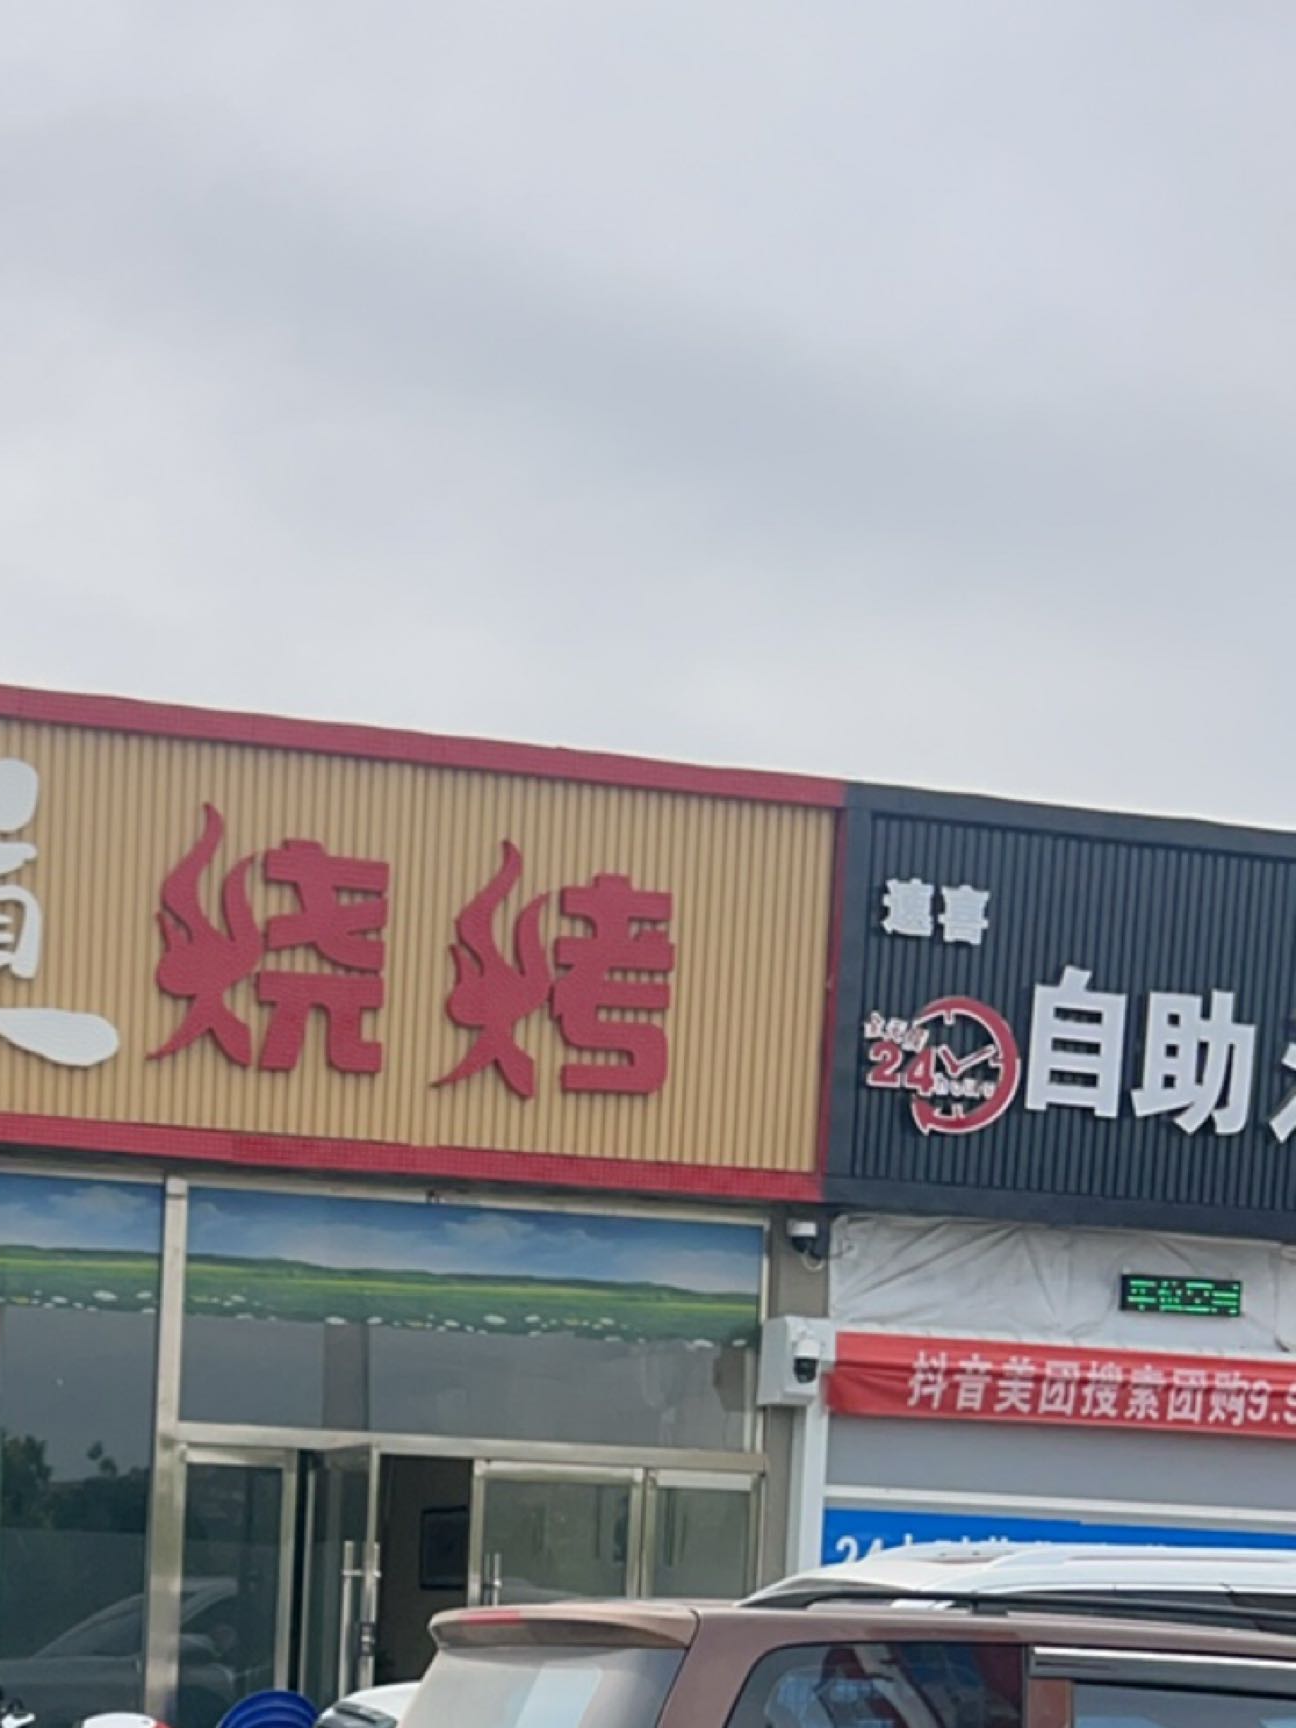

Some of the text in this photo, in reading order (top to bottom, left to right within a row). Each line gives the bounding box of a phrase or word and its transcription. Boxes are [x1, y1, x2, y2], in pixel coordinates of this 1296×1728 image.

[145, 802, 675, 1099] 烧烤
[866, 1040, 937, 1097] 24
[1025, 964, 1296, 1143] 自助
